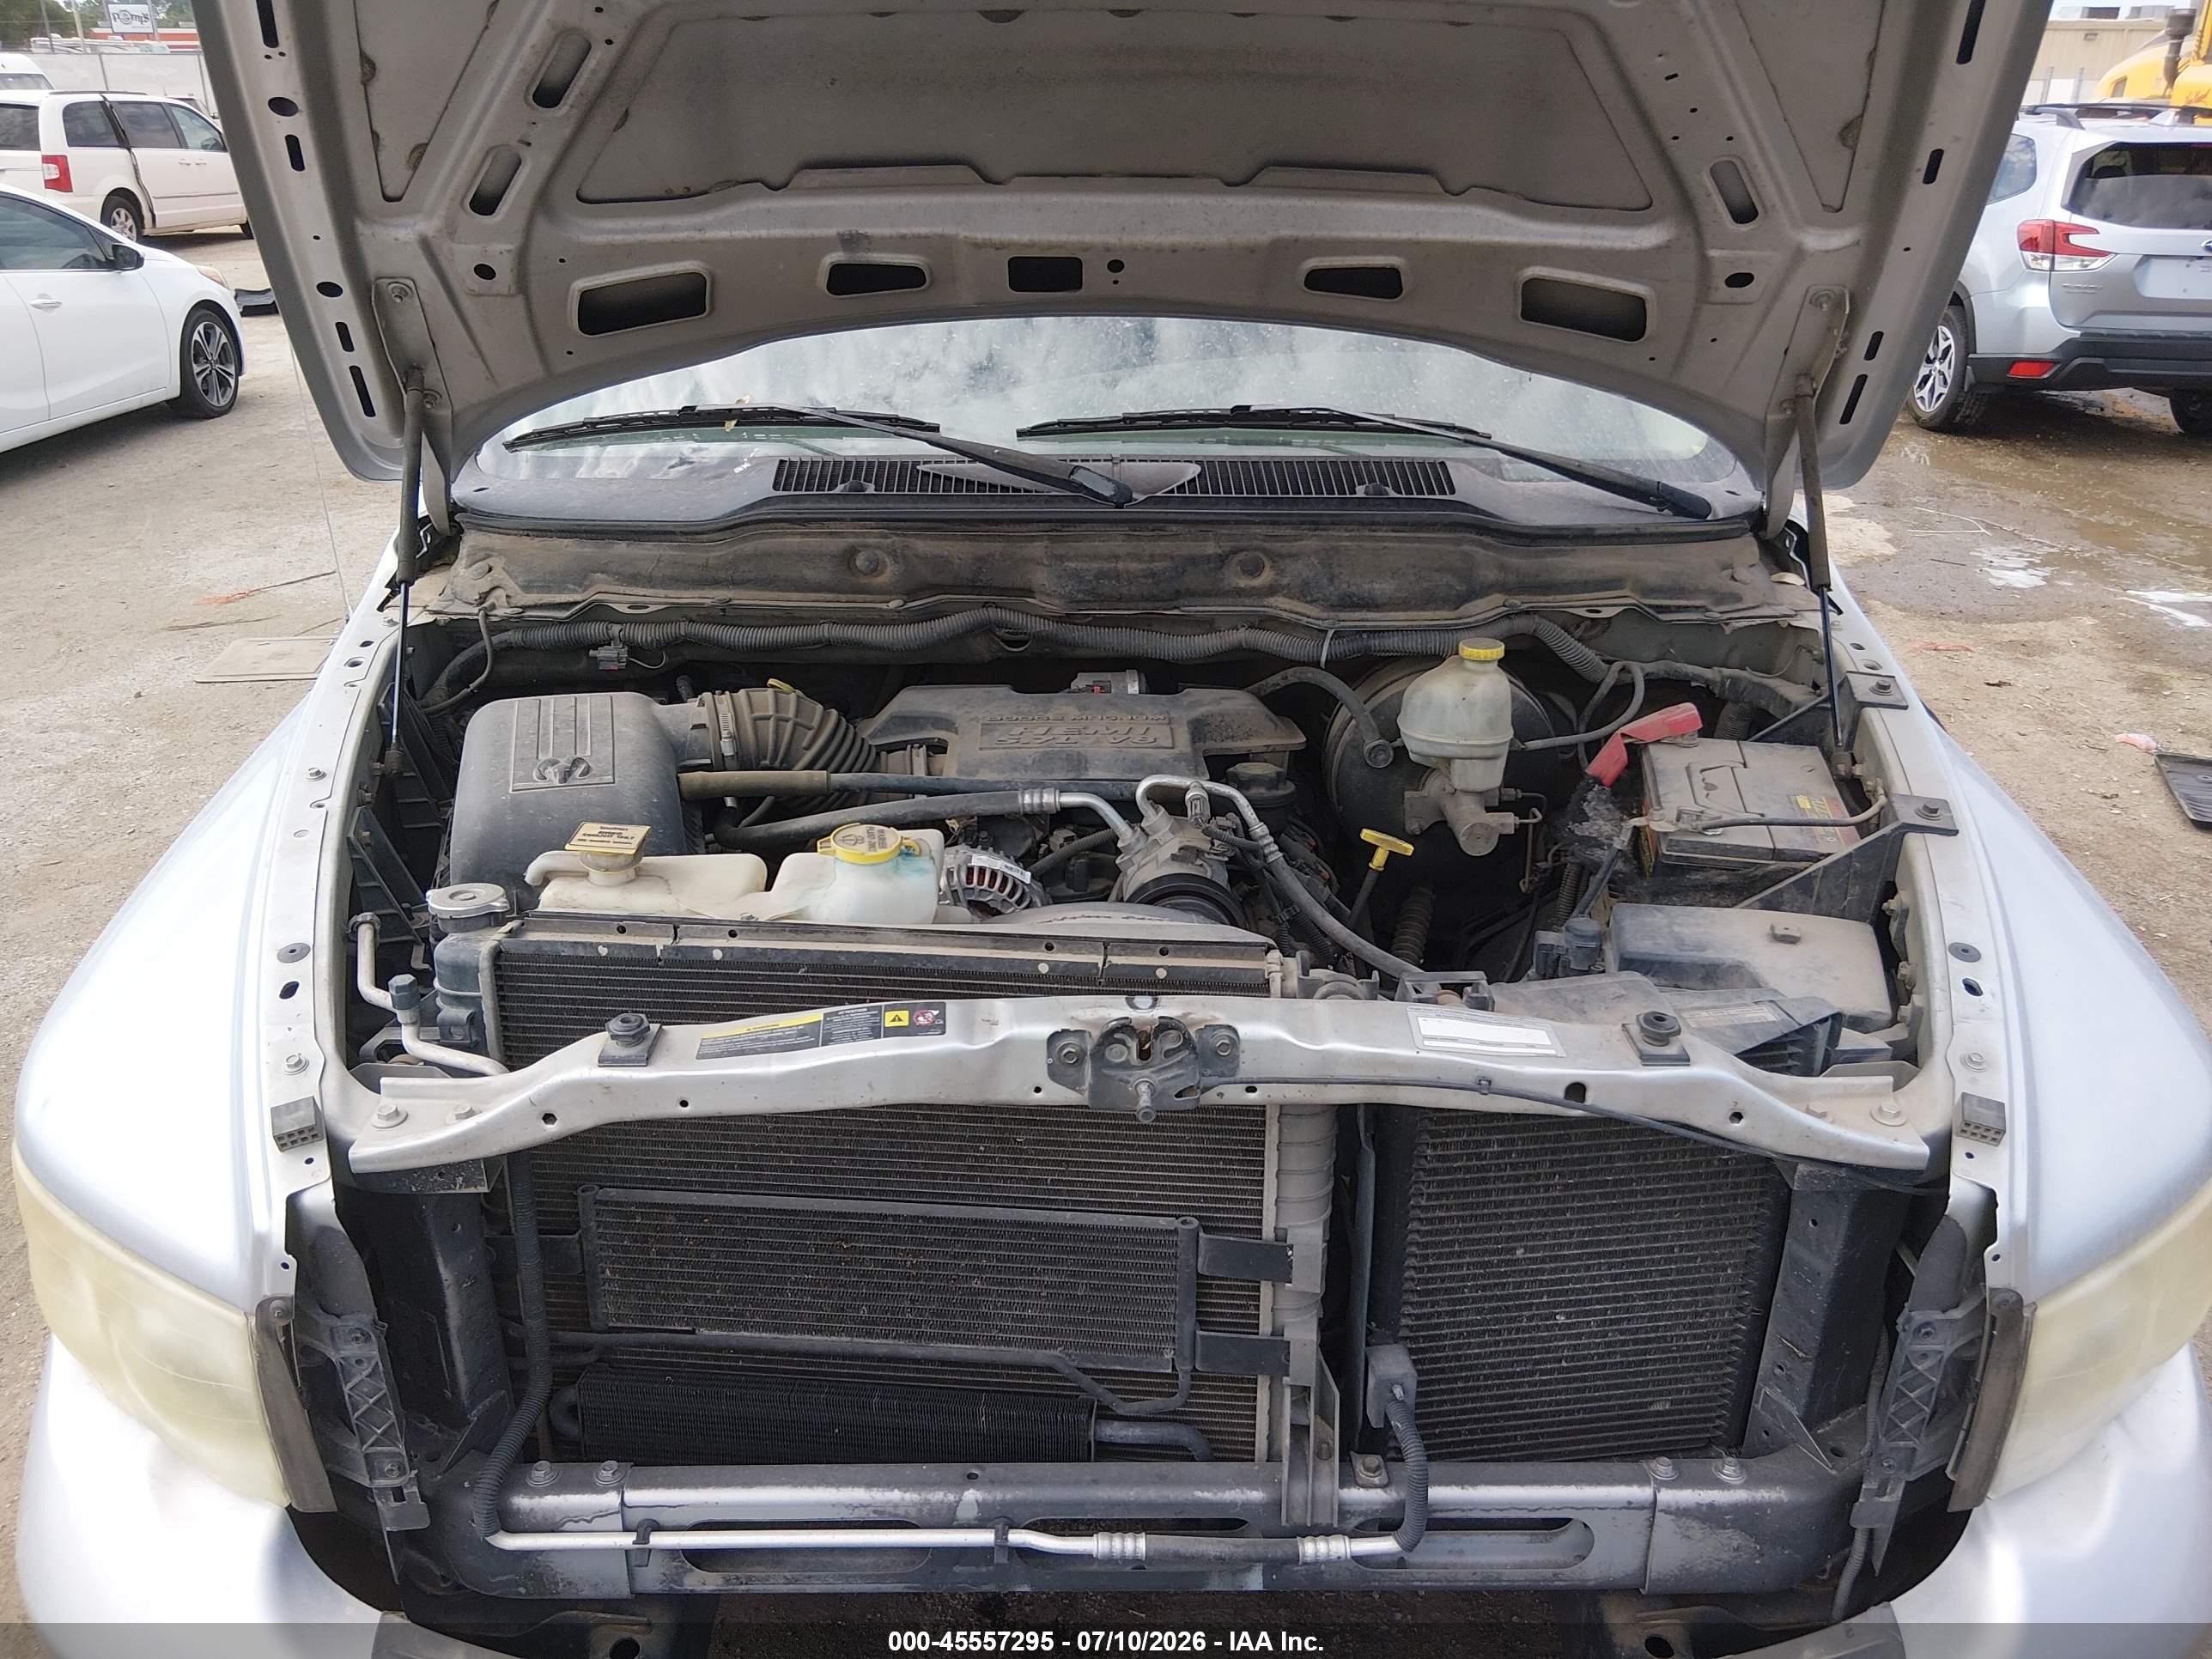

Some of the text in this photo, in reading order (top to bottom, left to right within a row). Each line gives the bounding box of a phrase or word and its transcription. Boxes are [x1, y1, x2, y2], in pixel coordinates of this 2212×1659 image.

[1008, 725, 1151, 737] HEMI
[994, 736, 1158, 745] 5.7L V8
